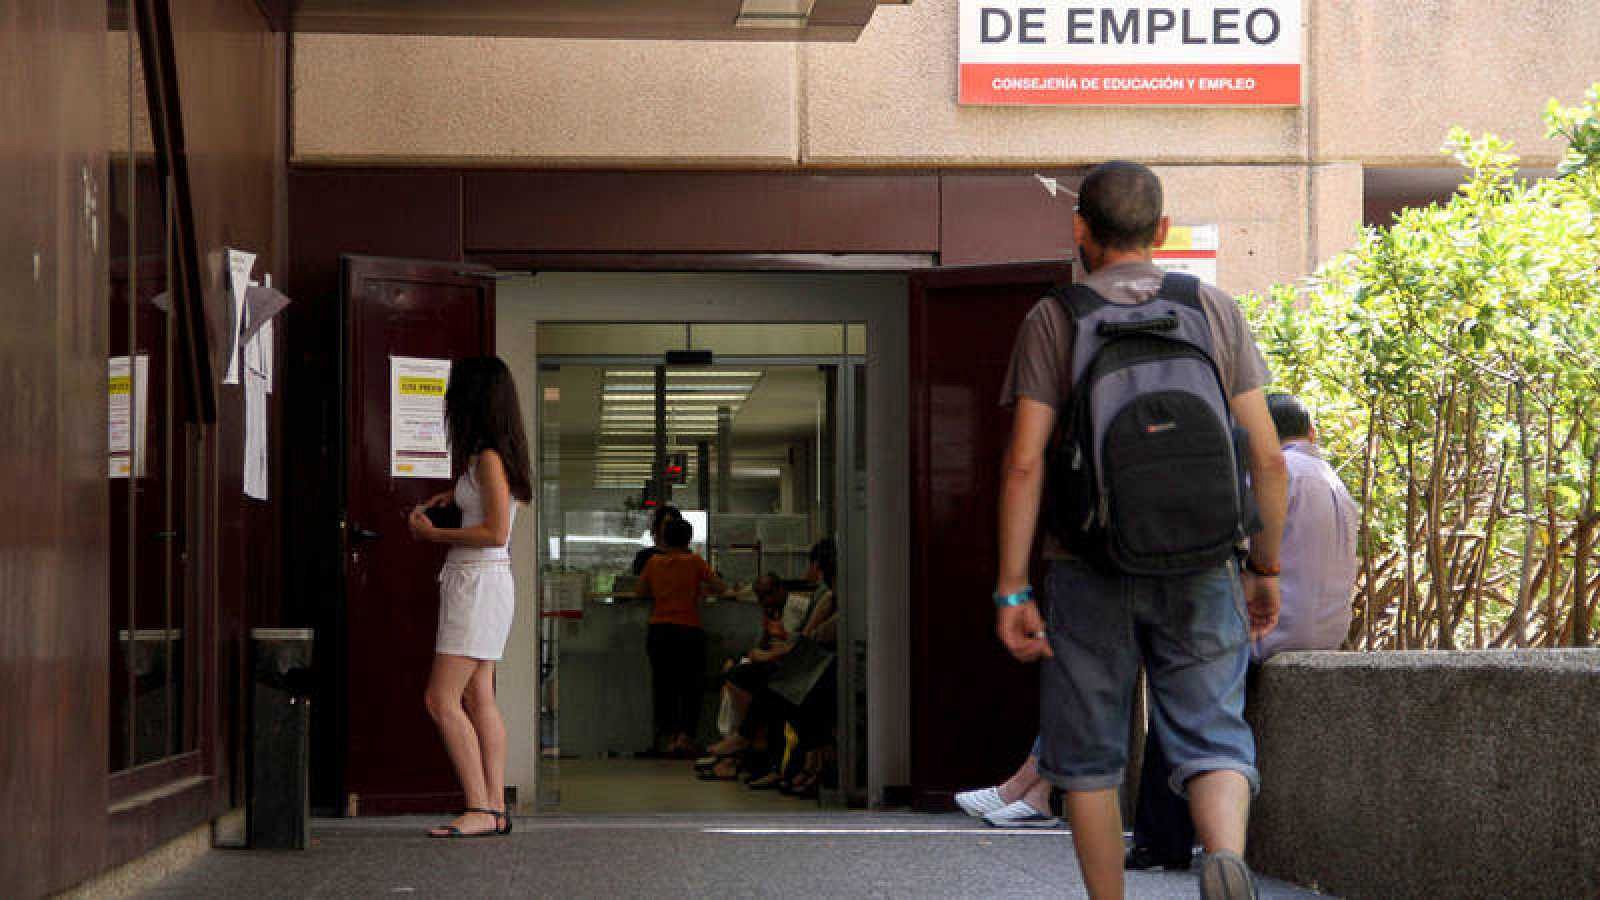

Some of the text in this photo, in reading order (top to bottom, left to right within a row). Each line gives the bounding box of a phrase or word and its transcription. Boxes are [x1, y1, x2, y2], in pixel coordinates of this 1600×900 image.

[980, 7, 1281, 45] DE EMPLEO
[992, 74, 1256, 91] CONSEJERÍA DE EDUCACIÓN Y EMPLEO
